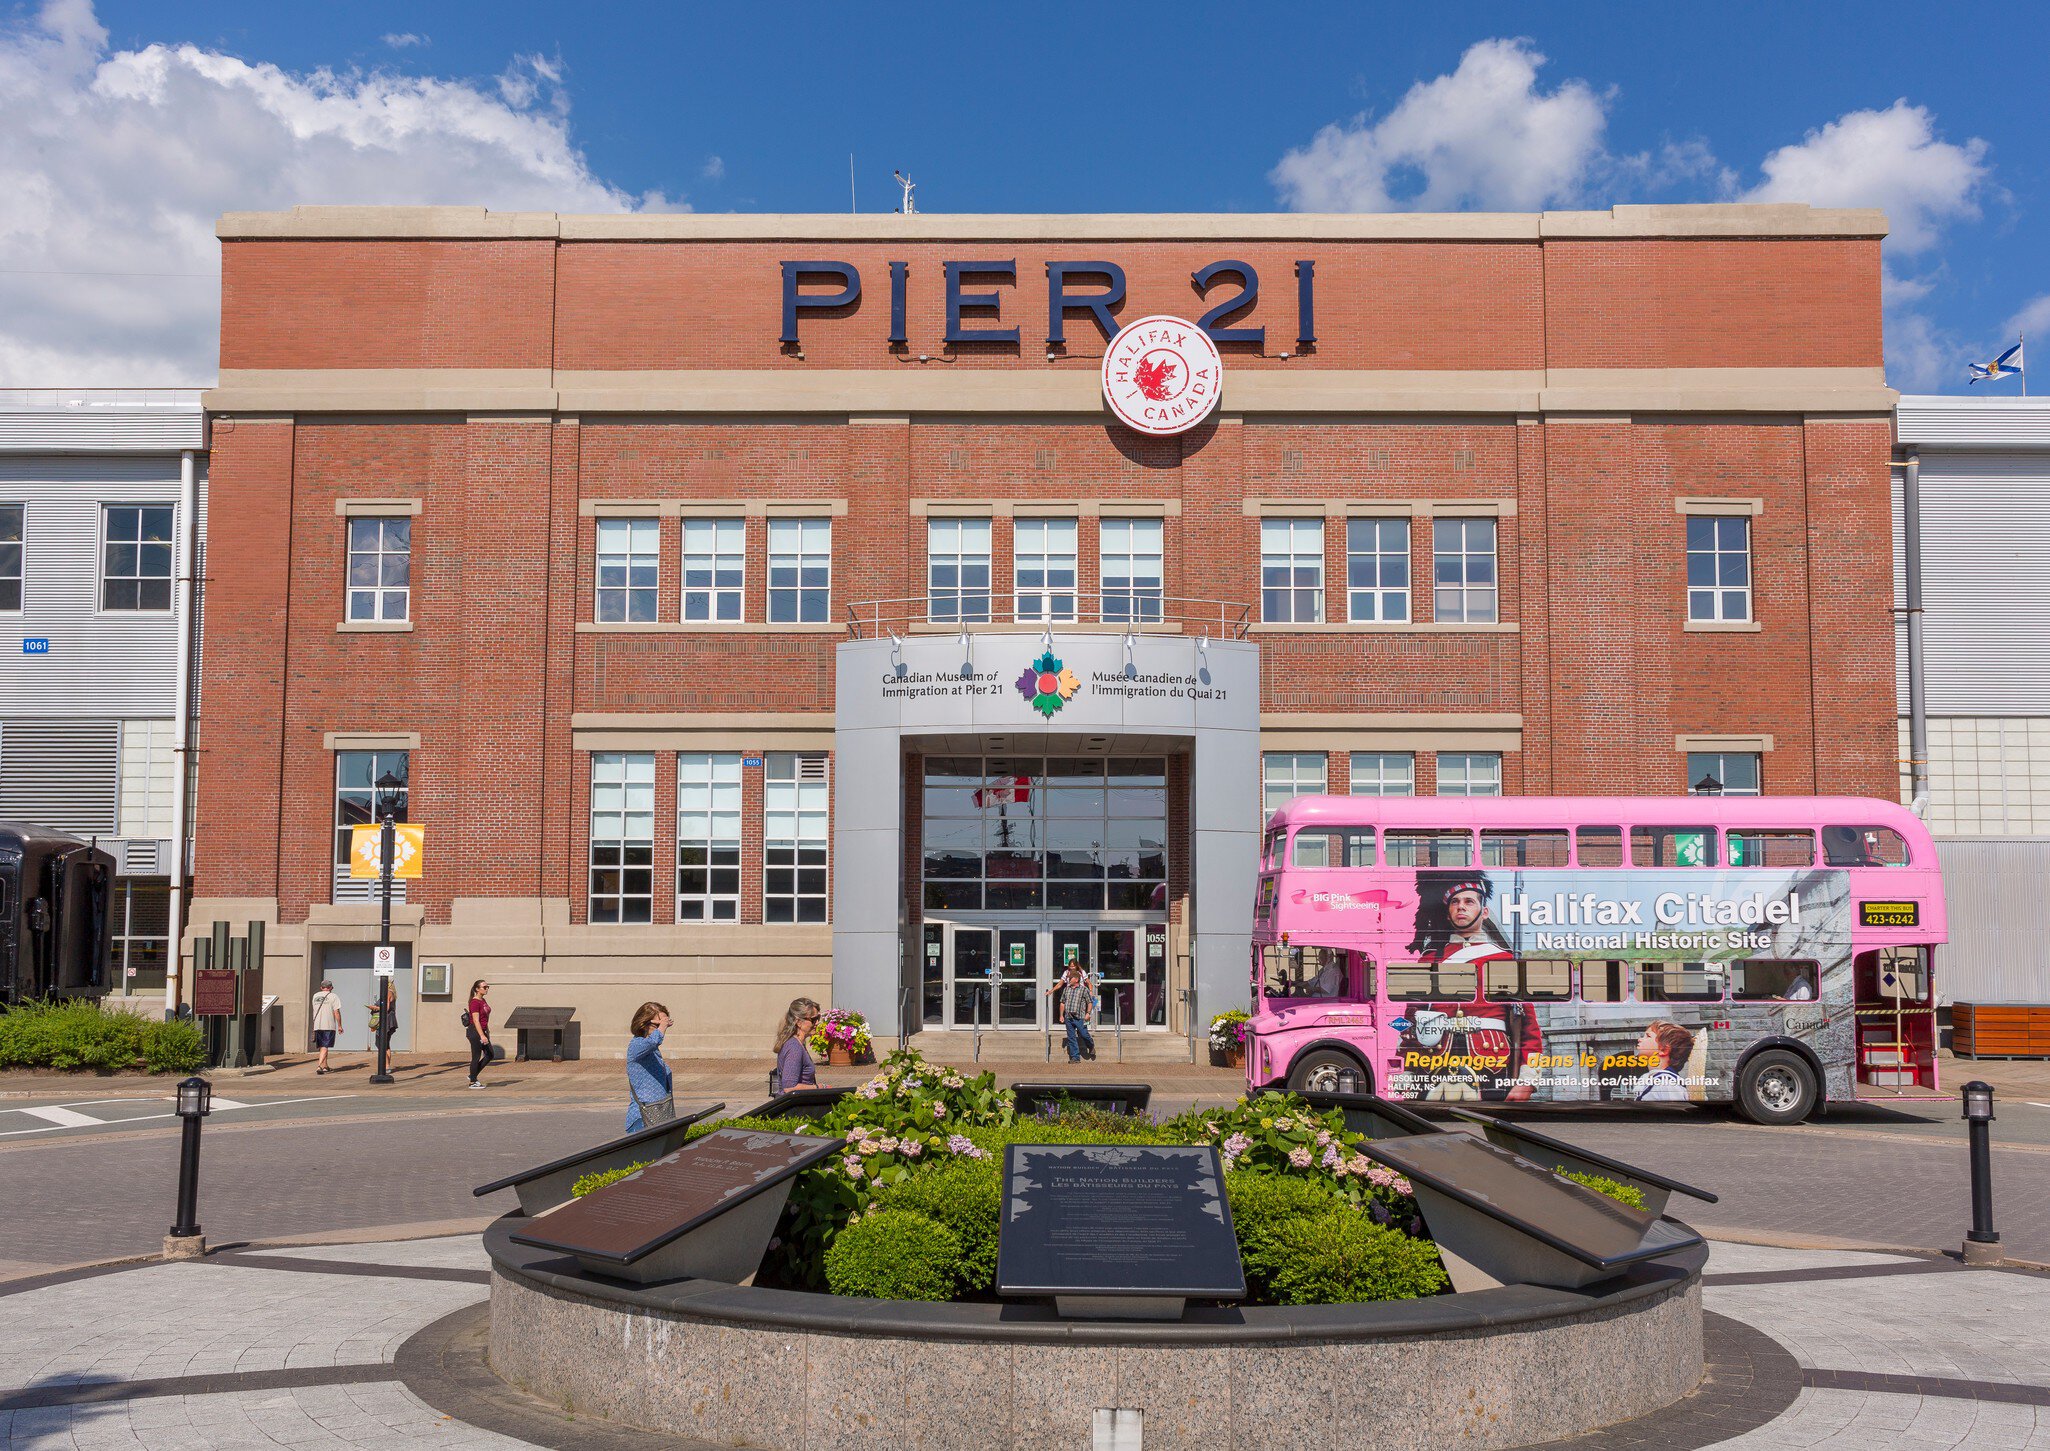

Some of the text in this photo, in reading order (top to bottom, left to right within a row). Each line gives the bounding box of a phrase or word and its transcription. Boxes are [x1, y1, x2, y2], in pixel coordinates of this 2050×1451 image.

[779, 260, 1316, 343] PIER 21
[1116, 330, 1187, 383] HALIFAX
[1144, 368, 1209, 421] CANADA
[25, 641, 47, 650] 1061
[882, 670, 999, 685] Canadian Museum of
[1091, 671, 1197, 685] Musée canadien de
[882, 684, 1004, 699] Immigration at Pier 21
[1092, 684, 1227, 701] l'immigration du Quai 21
[1313, 893, 1351, 902] BIG Pink
[1330, 901, 1379, 911] Sightseeing
[1501, 892, 1799, 925] Halifax Citadel
[1866, 914, 1915, 924] 423-6242
[1146, 933, 1166, 943] 1055
[1537, 931, 1772, 949] National Historic Site
[1785, 1018, 1830, 1030] Canada
[1405, 1052, 1660, 1071] Replongez dans le passé
[1387, 1074, 1490, 1083] ABSOLUTE CHARTERS INC.
[1495, 1075, 1720, 1088] parcscanada.gc.ca/citadellehalifax
[1387, 1083, 1436, 1092] HALIFAX, NS
[1388, 1091, 1419, 1099] MC 2697
